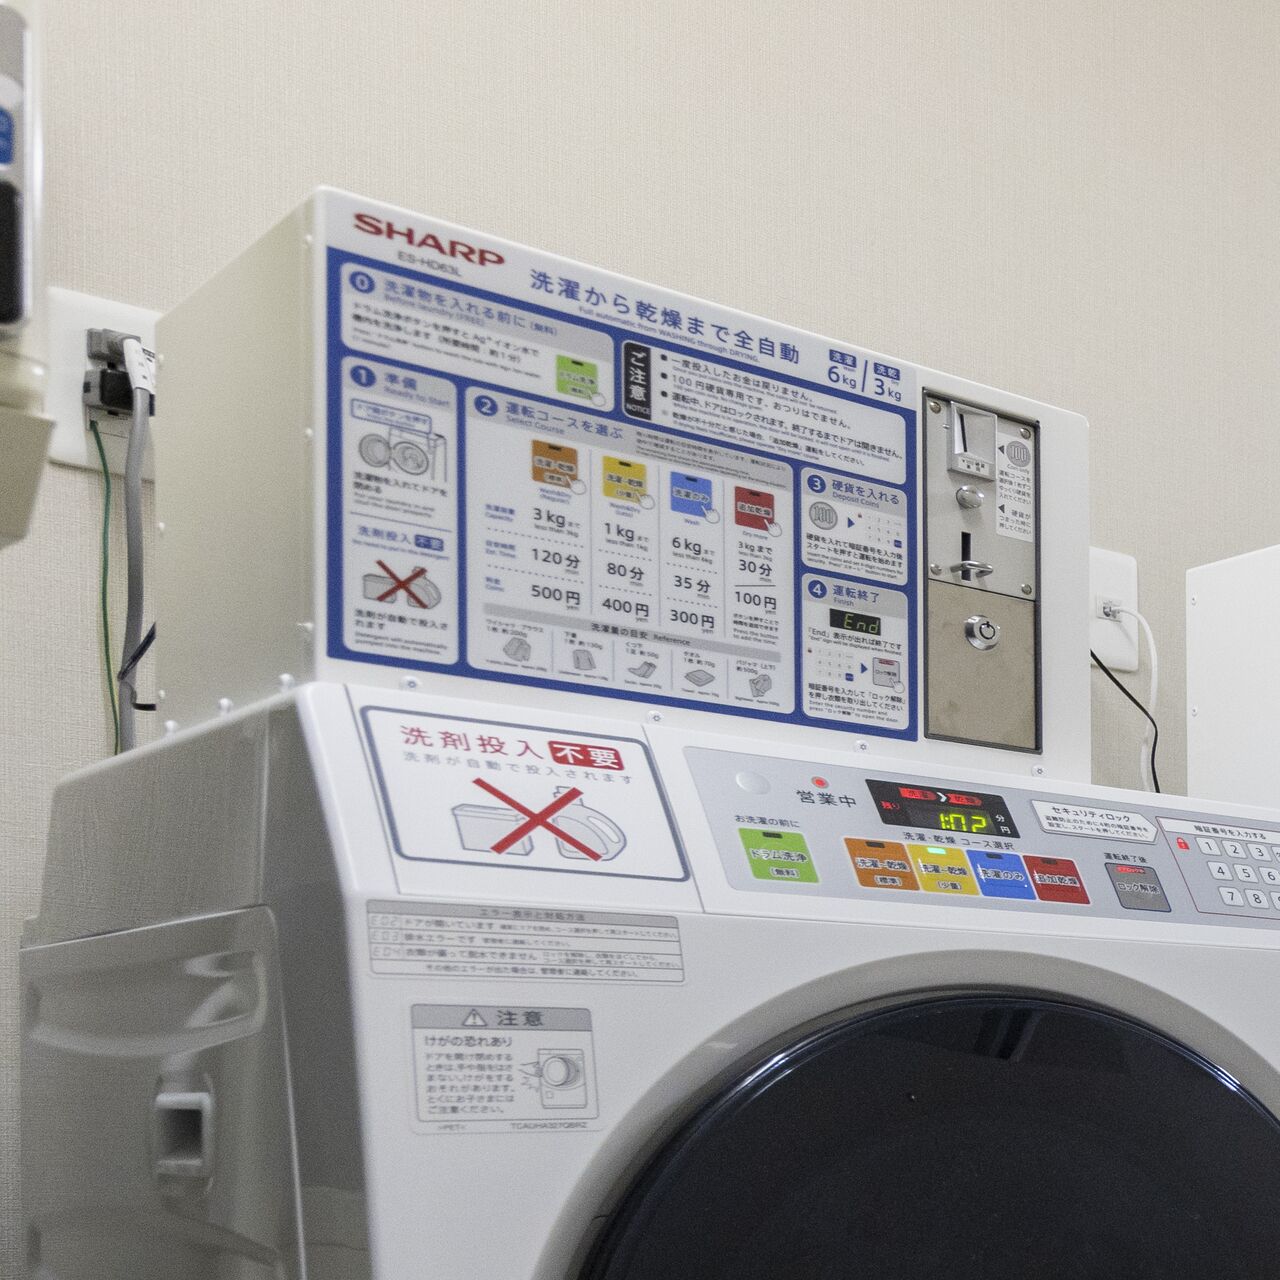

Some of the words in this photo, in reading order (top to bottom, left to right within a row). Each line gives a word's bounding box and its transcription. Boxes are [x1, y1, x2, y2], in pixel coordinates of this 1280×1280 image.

[354, 213, 505, 266] SHARP
[384, 279, 525, 330] 洗濯物を入れる前に
[530, 269, 799, 364] 洗濯から乾燥まで全自動
[506, 401, 623, 440] 運転コースを選ぶ
[832, 480, 900, 505] 硬貨を入れる
[547, 510, 566, 528] kg
[616, 524, 635, 542] kg
[684, 538, 702, 556] kg
[532, 548, 563, 565] 120
[566, 554, 581, 569] 分
[739, 559, 757, 574] 30
[759, 563, 773, 577] 分
[607, 562, 627, 577] 80
[630, 566, 644, 581] 分
[674, 575, 692, 590] 35
[697, 580, 711, 594] 分
[832, 584, 880, 603] 運転終了
[531, 584, 563, 601] 500
[566, 591, 580, 606] 円
[736, 591, 761, 606] 100
[764, 596, 777, 611] 円
[602, 598, 632, 614] 400
[635, 602, 649, 617] 円
[670, 609, 699, 625] 300
[701, 615, 715, 629] 円
[844, 613, 879, 633] End
[591, 621, 648, 641] 洗濯量の目安
[400, 725, 545, 760] 洗剤投入
[553, 744, 620, 769] 不要
[403, 751, 632, 785] 洗剤が自動で投入されます
[796, 790, 856, 808] 営業中
[734, 814, 801, 828] お洗濯の前に
[1051, 806, 1131, 822] セキュリティロック
[1194, 823, 1267, 840] 暗証番号を入力する
[960, 837, 1015, 851] コース選択
[1230, 844, 1240, 854] 2
[1256, 846, 1264, 857] 3
[750, 847, 807, 863] ドラム洗浄
[1215, 866, 1226, 876] 4
[1242, 868, 1251, 879] 5
[1266, 871, 1276, 881] 6
[1118, 882, 1159, 895] ロック解除
[1227, 891, 1235, 901] 7
[1252, 893, 1262, 904] 8
[497, 1009, 544, 1027] 注意
[424, 1035, 513, 1048] けがの恐れあり
